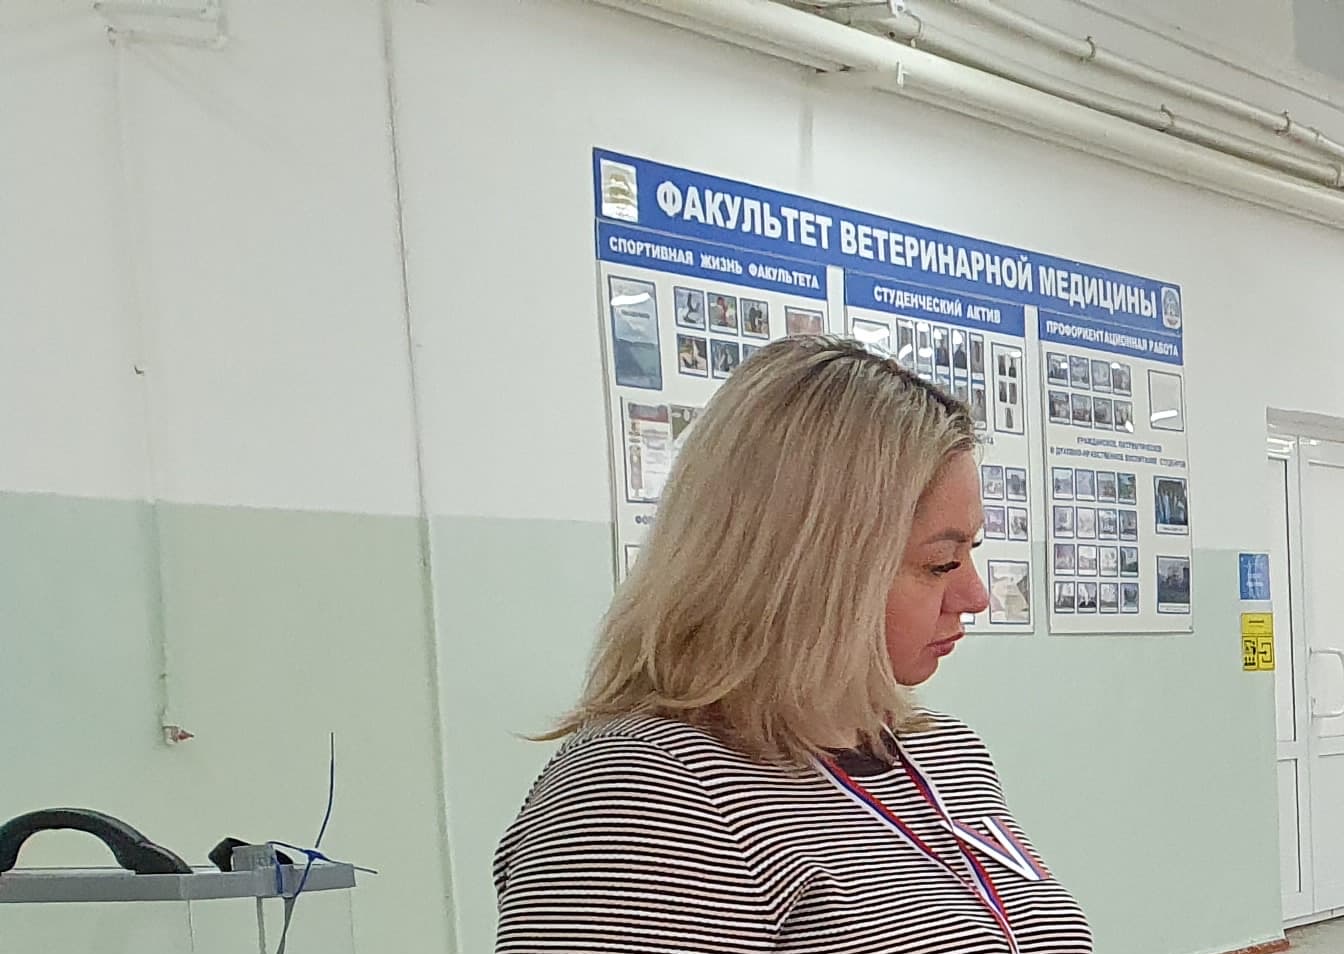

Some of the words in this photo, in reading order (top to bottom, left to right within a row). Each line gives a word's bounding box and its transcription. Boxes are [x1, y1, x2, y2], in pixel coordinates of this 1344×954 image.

[608, 236, 694, 266] СПОРТИВНАЯ
[700, 254, 743, 275] ЖИЗНЬ
[748, 263, 820, 290] ФАКУЛЬТЕТА
[656, 180, 832, 250] ФАКУЛЬТЕТ
[840, 220, 1034, 293] ВЕТЕРИНАРНОЙ
[1038, 265, 1157, 320] МЕДИЦИНЫ
[874, 285, 962, 317] СТУДЕНЧЕСКИЙ
[966, 306, 1001, 325] АКТИВ
[1046, 320, 1148, 351] ПРОФОРИЕНТАЦИОННАЯ
[1148, 339, 1179, 357] РАБОТА
